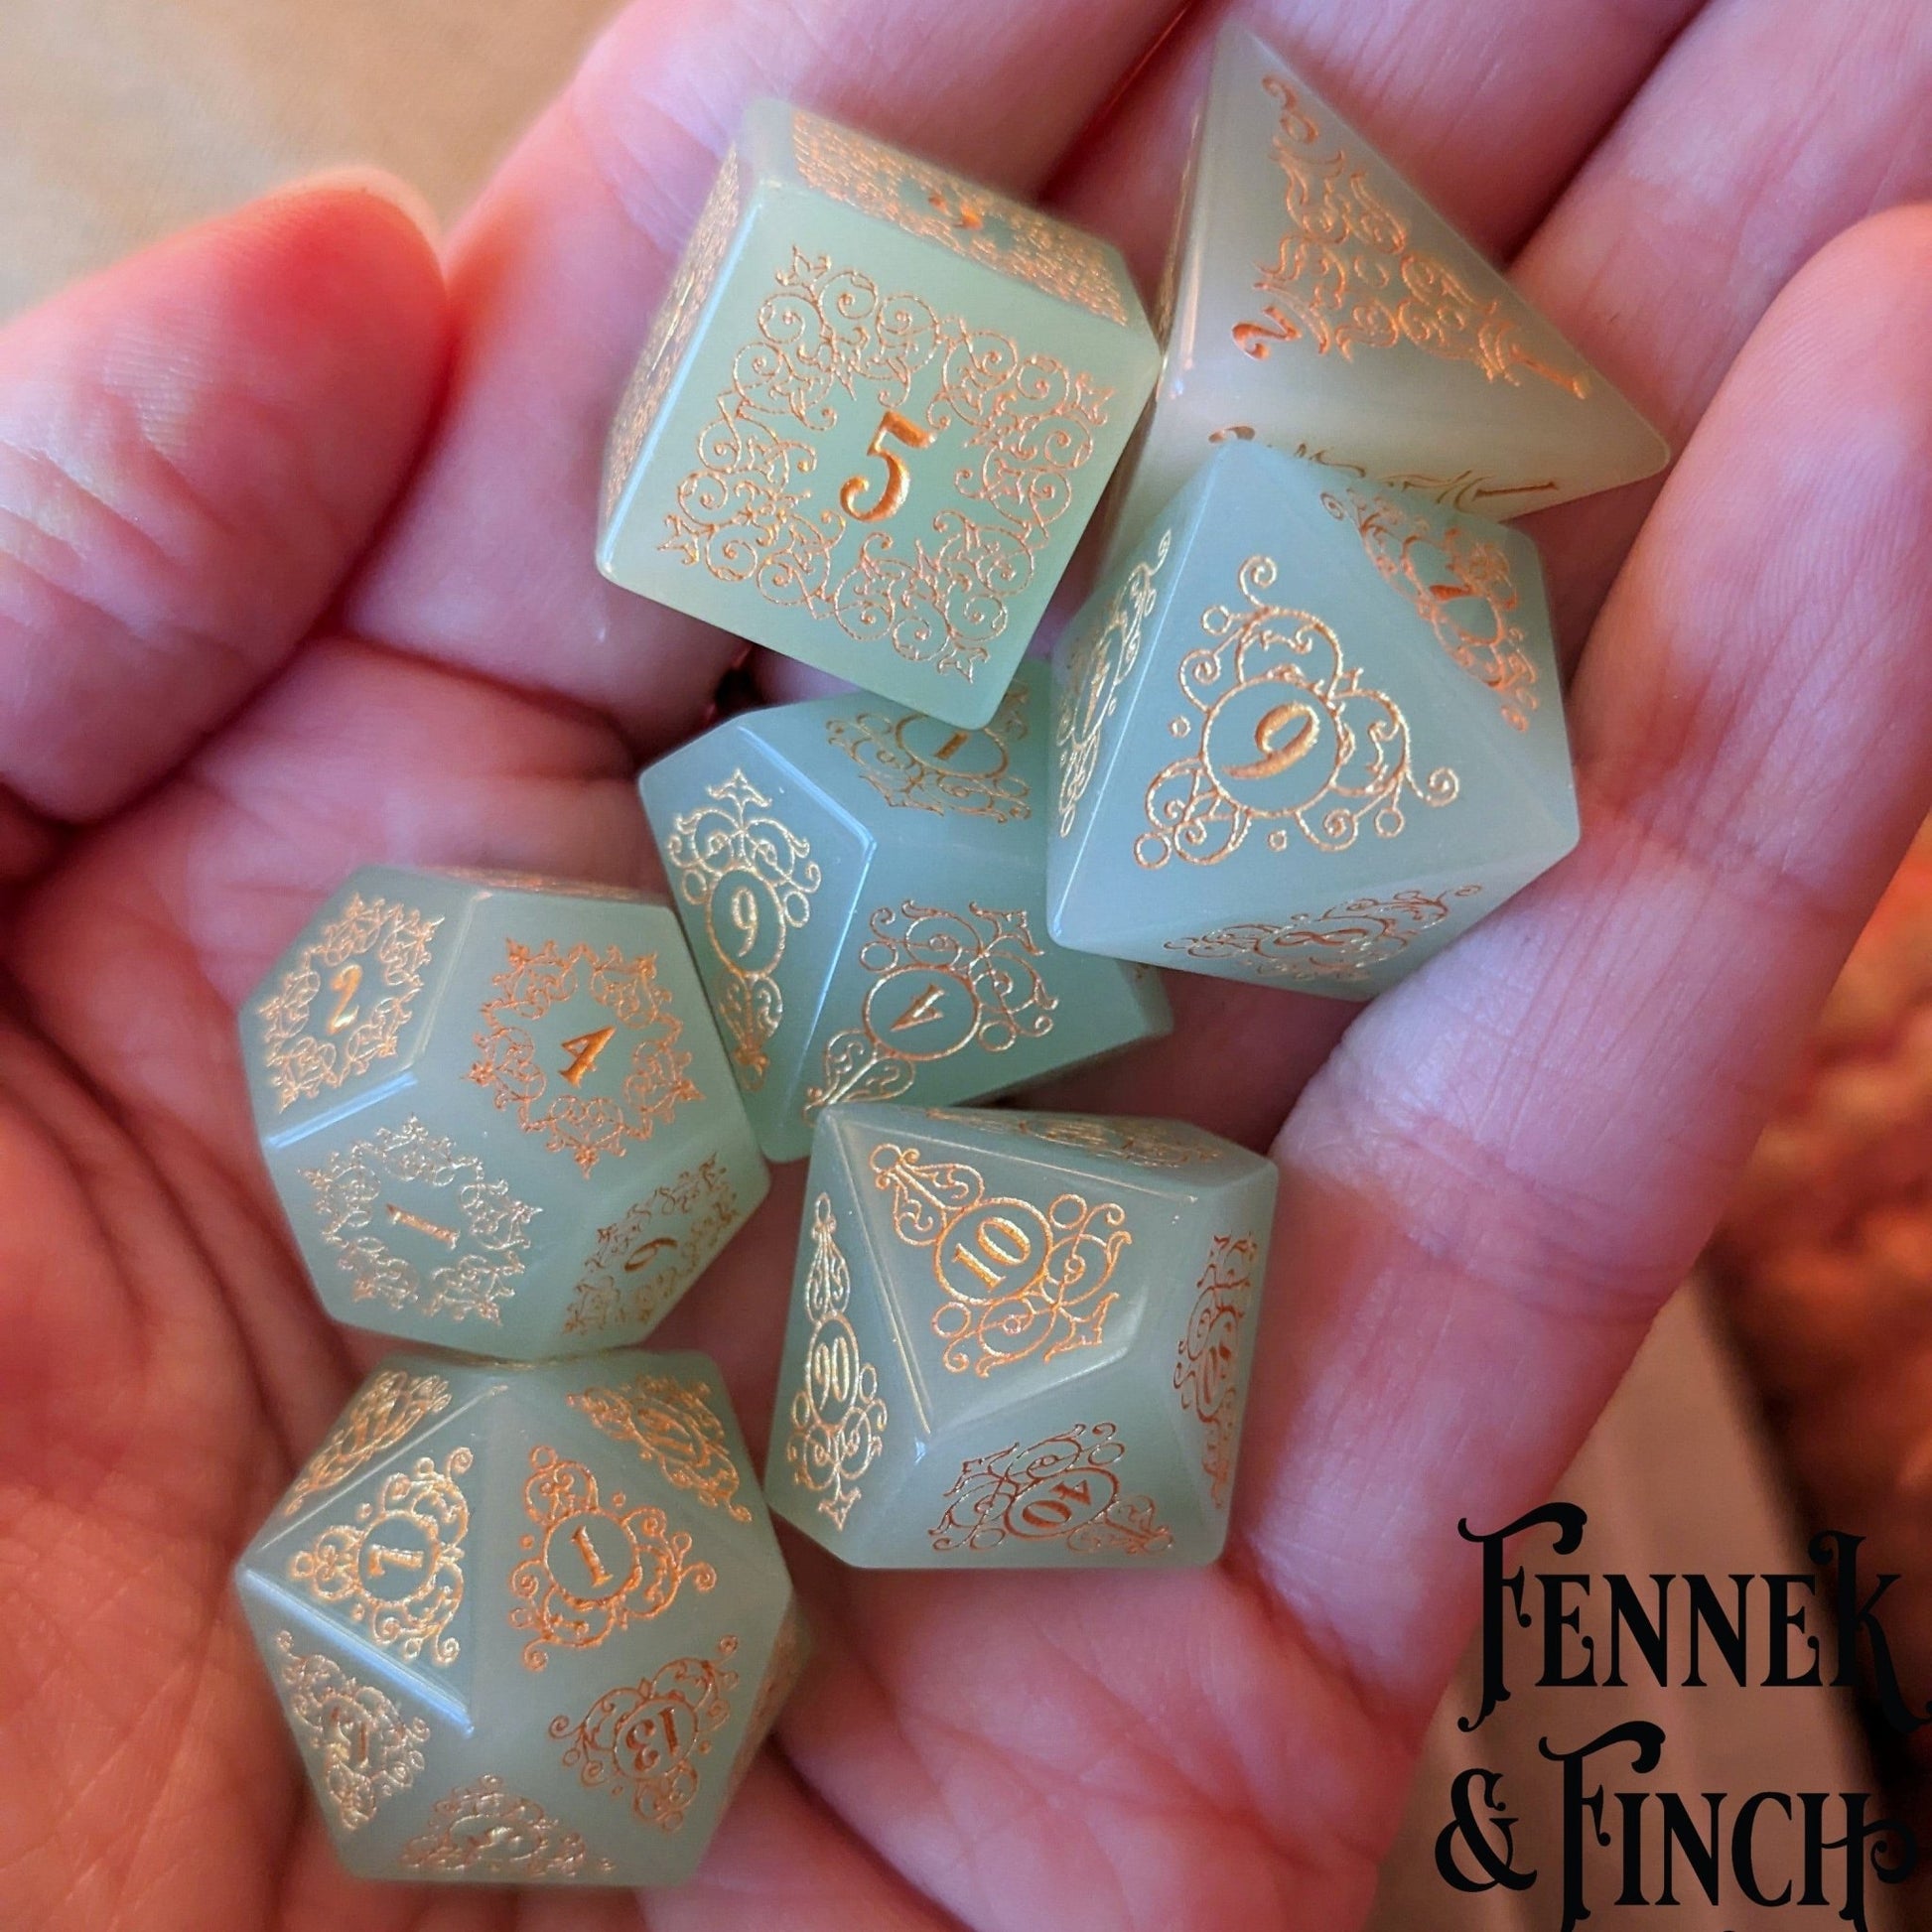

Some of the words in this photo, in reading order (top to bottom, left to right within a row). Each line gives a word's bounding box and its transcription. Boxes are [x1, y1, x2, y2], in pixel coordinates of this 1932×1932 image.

[1232, 306, 1302, 360] 2
[840, 410, 937, 521] 5
[329, 963, 362, 1035] 2
[558, 1026, 618, 1088] 4
[952, 1215, 1033, 1290] 10
[572, 1524, 614, 1587] 1
